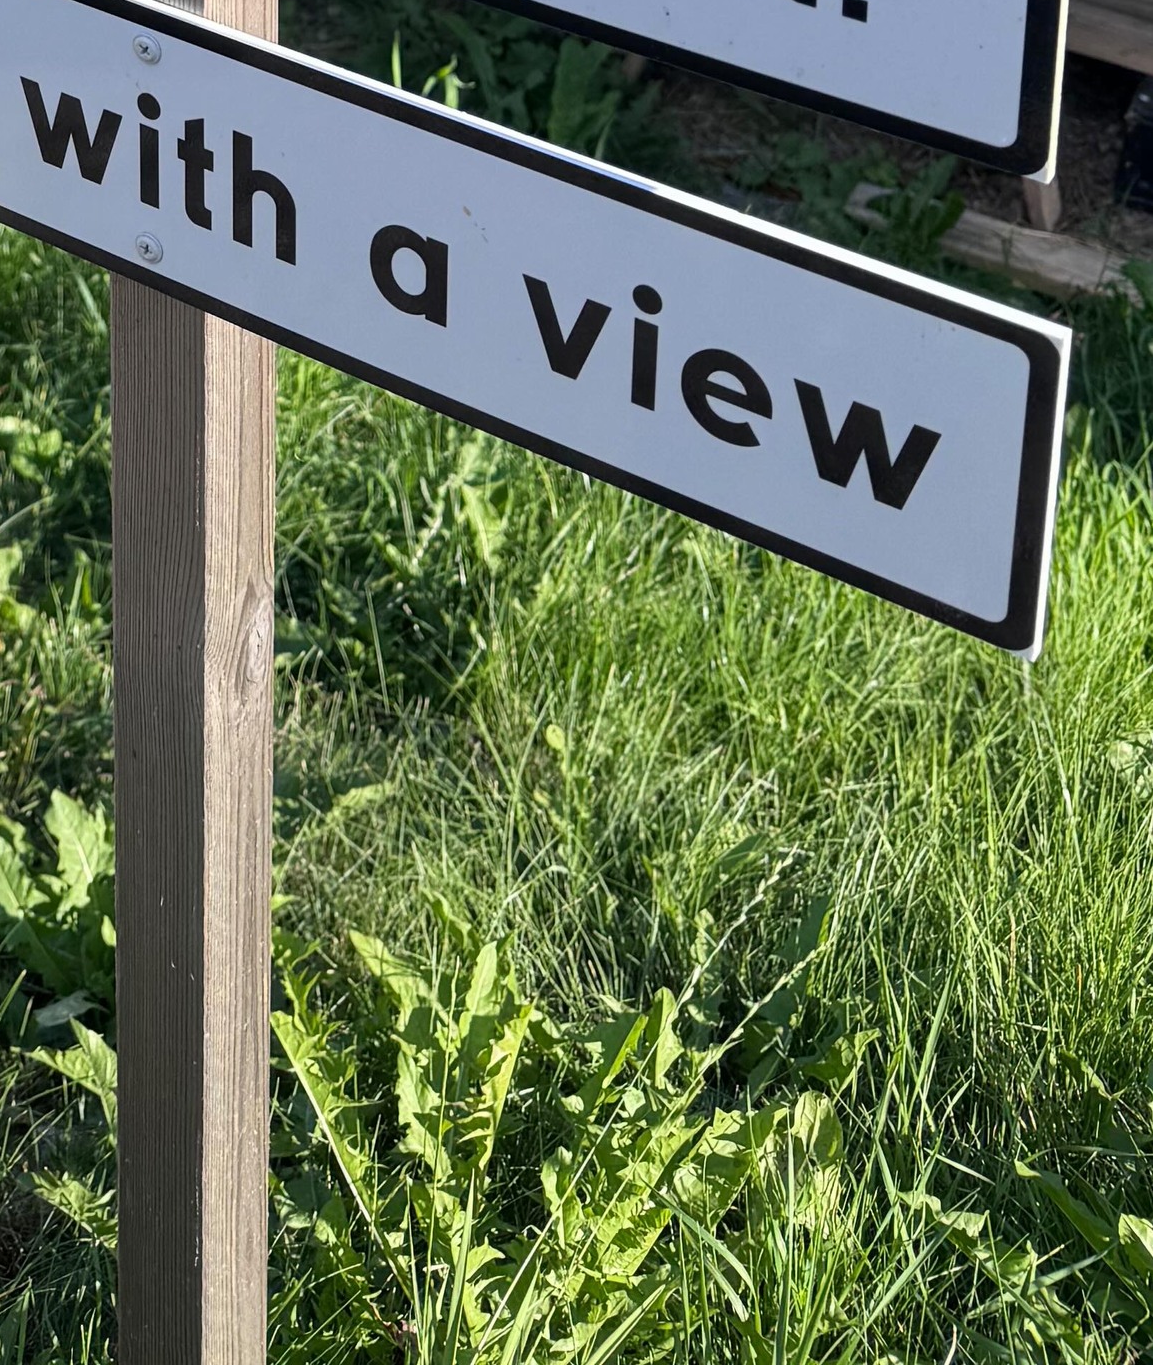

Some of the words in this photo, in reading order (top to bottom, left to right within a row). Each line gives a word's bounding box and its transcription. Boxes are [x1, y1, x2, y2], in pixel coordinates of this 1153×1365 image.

[19, 74, 298, 267] with
[368, 223, 450, 329] a
[521, 272, 943, 512] view
